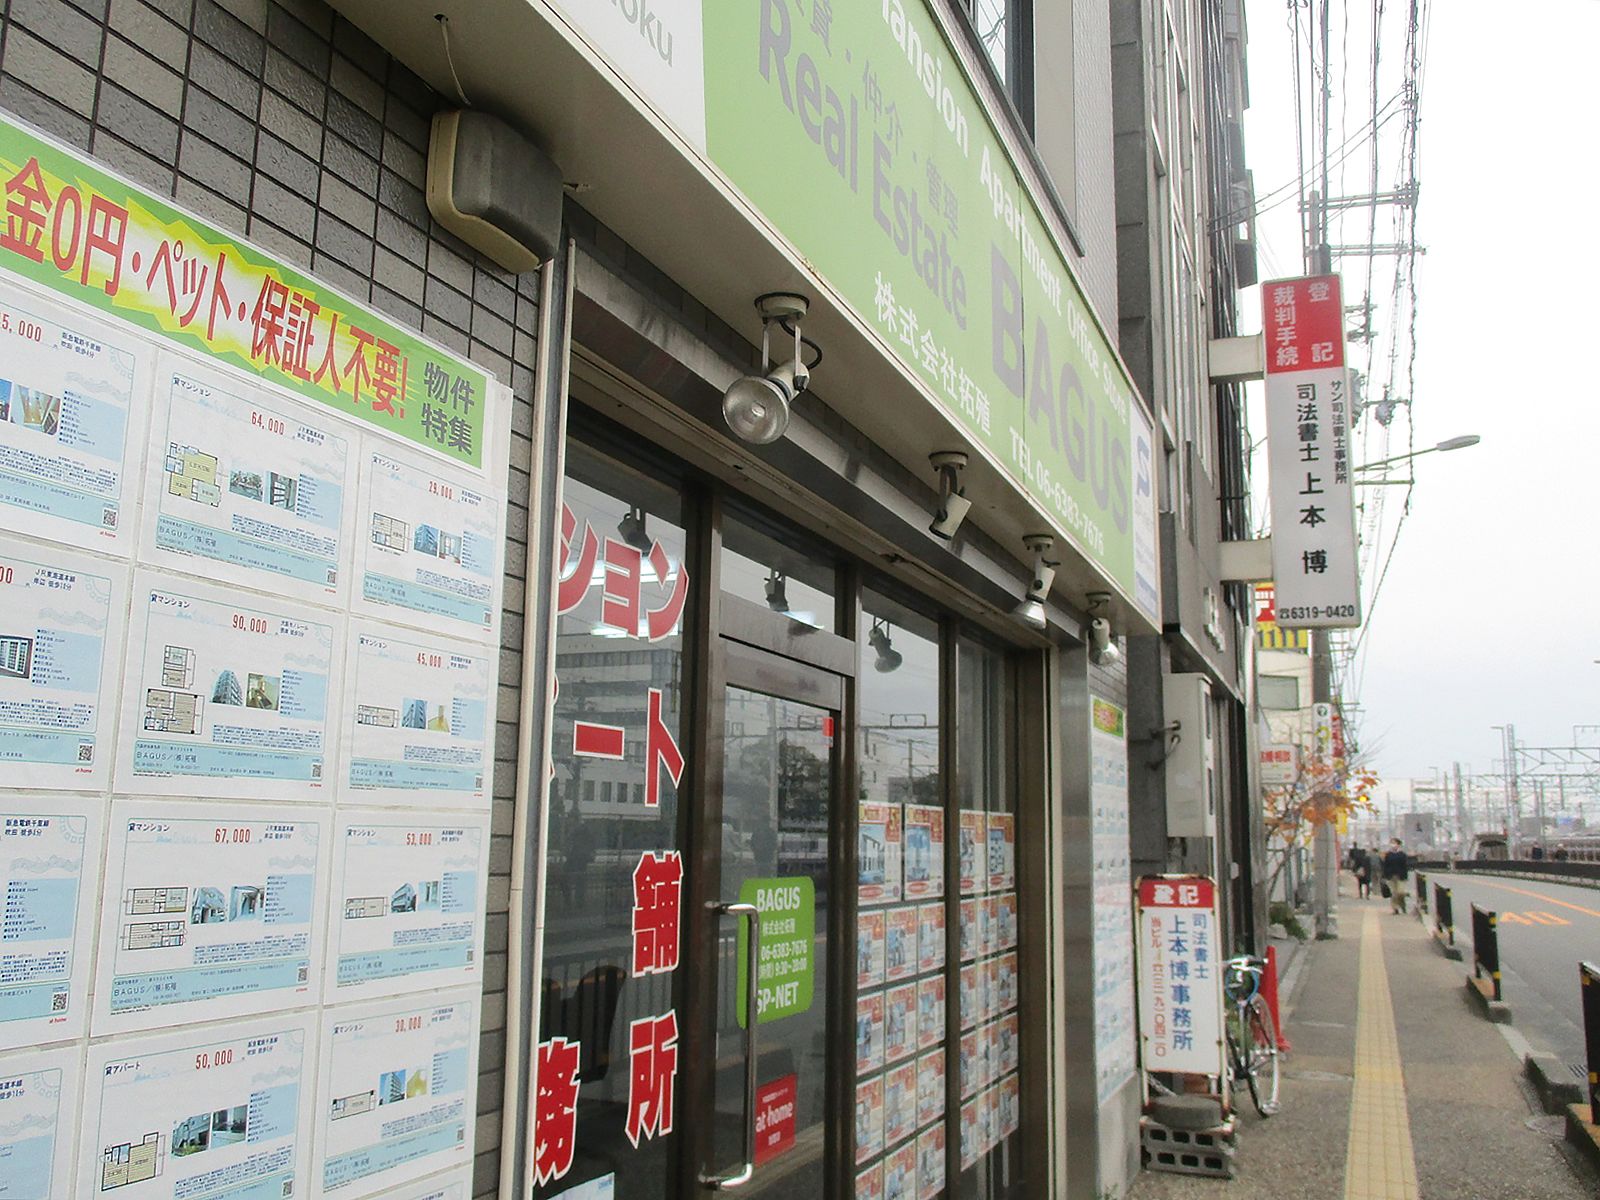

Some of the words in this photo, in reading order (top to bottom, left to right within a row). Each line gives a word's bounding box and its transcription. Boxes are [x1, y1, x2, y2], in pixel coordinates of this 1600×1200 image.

[612, 0, 673, 67] oku
[759, 0, 859, 196] Real
[873, 131, 967, 332] Estate
[981, 144, 1062, 316] Apartment
[1274, 286, 1299, 367] 裁判手続
[1308, 282, 1334, 363] 登記
[424, 362, 475, 416] 物件
[992, 240, 1129, 536] BAGUS
[251, 412, 285, 436] 64,000
[421, 402, 473, 456] 特集
[1009, 426, 1034, 481] TEL
[232, 614, 267, 634] 90,000
[1291, 604, 1355, 619] 6319-0420
[215, 828, 250, 845] 67,000
[757, 887, 801, 912] BAGUS
[1192, 913, 1208, 979] 司法書士
[195, 1049, 233, 1070] 50,000
